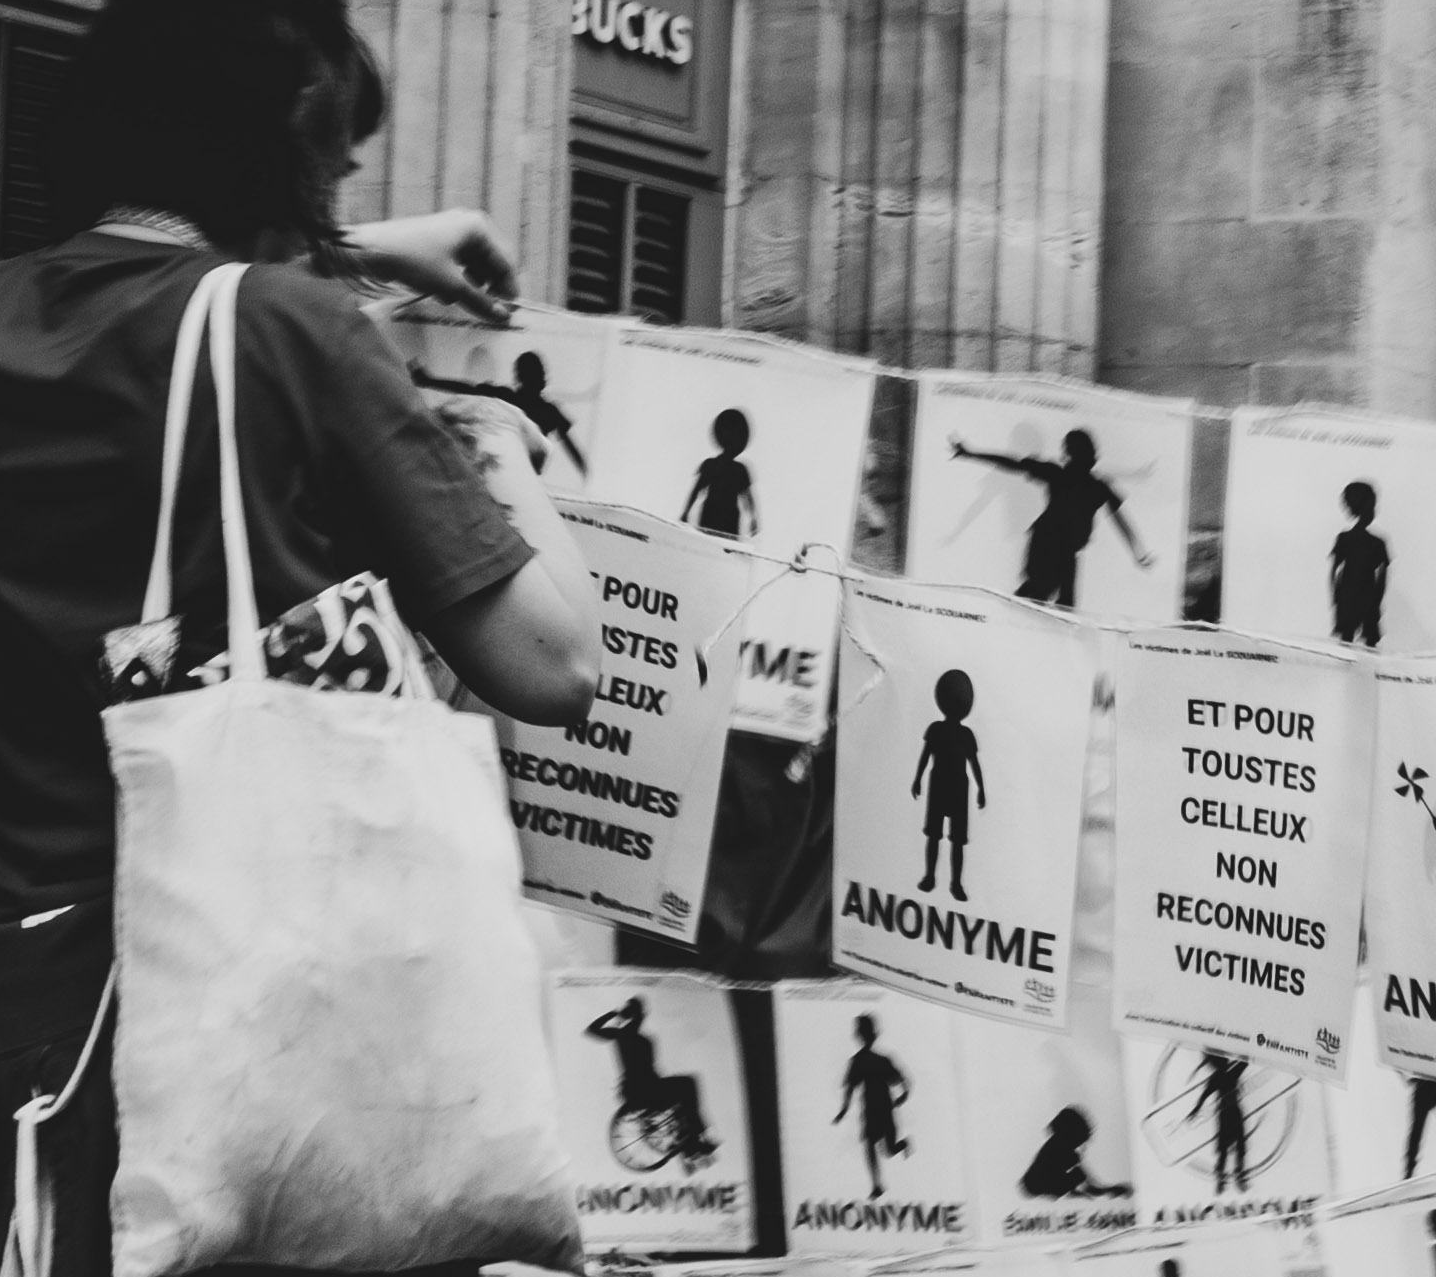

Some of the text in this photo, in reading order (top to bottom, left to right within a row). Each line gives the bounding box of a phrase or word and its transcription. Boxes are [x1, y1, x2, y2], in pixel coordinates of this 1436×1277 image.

[602, 575, 679, 623] POUR
[1182, 646, 1192, 656] de
[1194, 648, 1212, 658] Joël
[1214, 650, 1224, 659] Le
[595, 674, 667, 716] LEUX
[565, 721, 632, 756] NON
[1186, 699, 1315, 742] ET POUR
[501, 749, 681, 819] RECONNUES
[1181, 746, 1317, 794] TOUSTES
[508, 800, 654, 861] VICTIMES
[1179, 797, 1308, 844] CELLEUX
[1215, 851, 1278, 888] NON
[841, 880, 1056, 974] ANONYME
[1156, 892, 1327, 950] RECONNUES
[1174, 945, 1306, 997] VICTIMES
[792, 1199, 965, 1233] ANONYME
